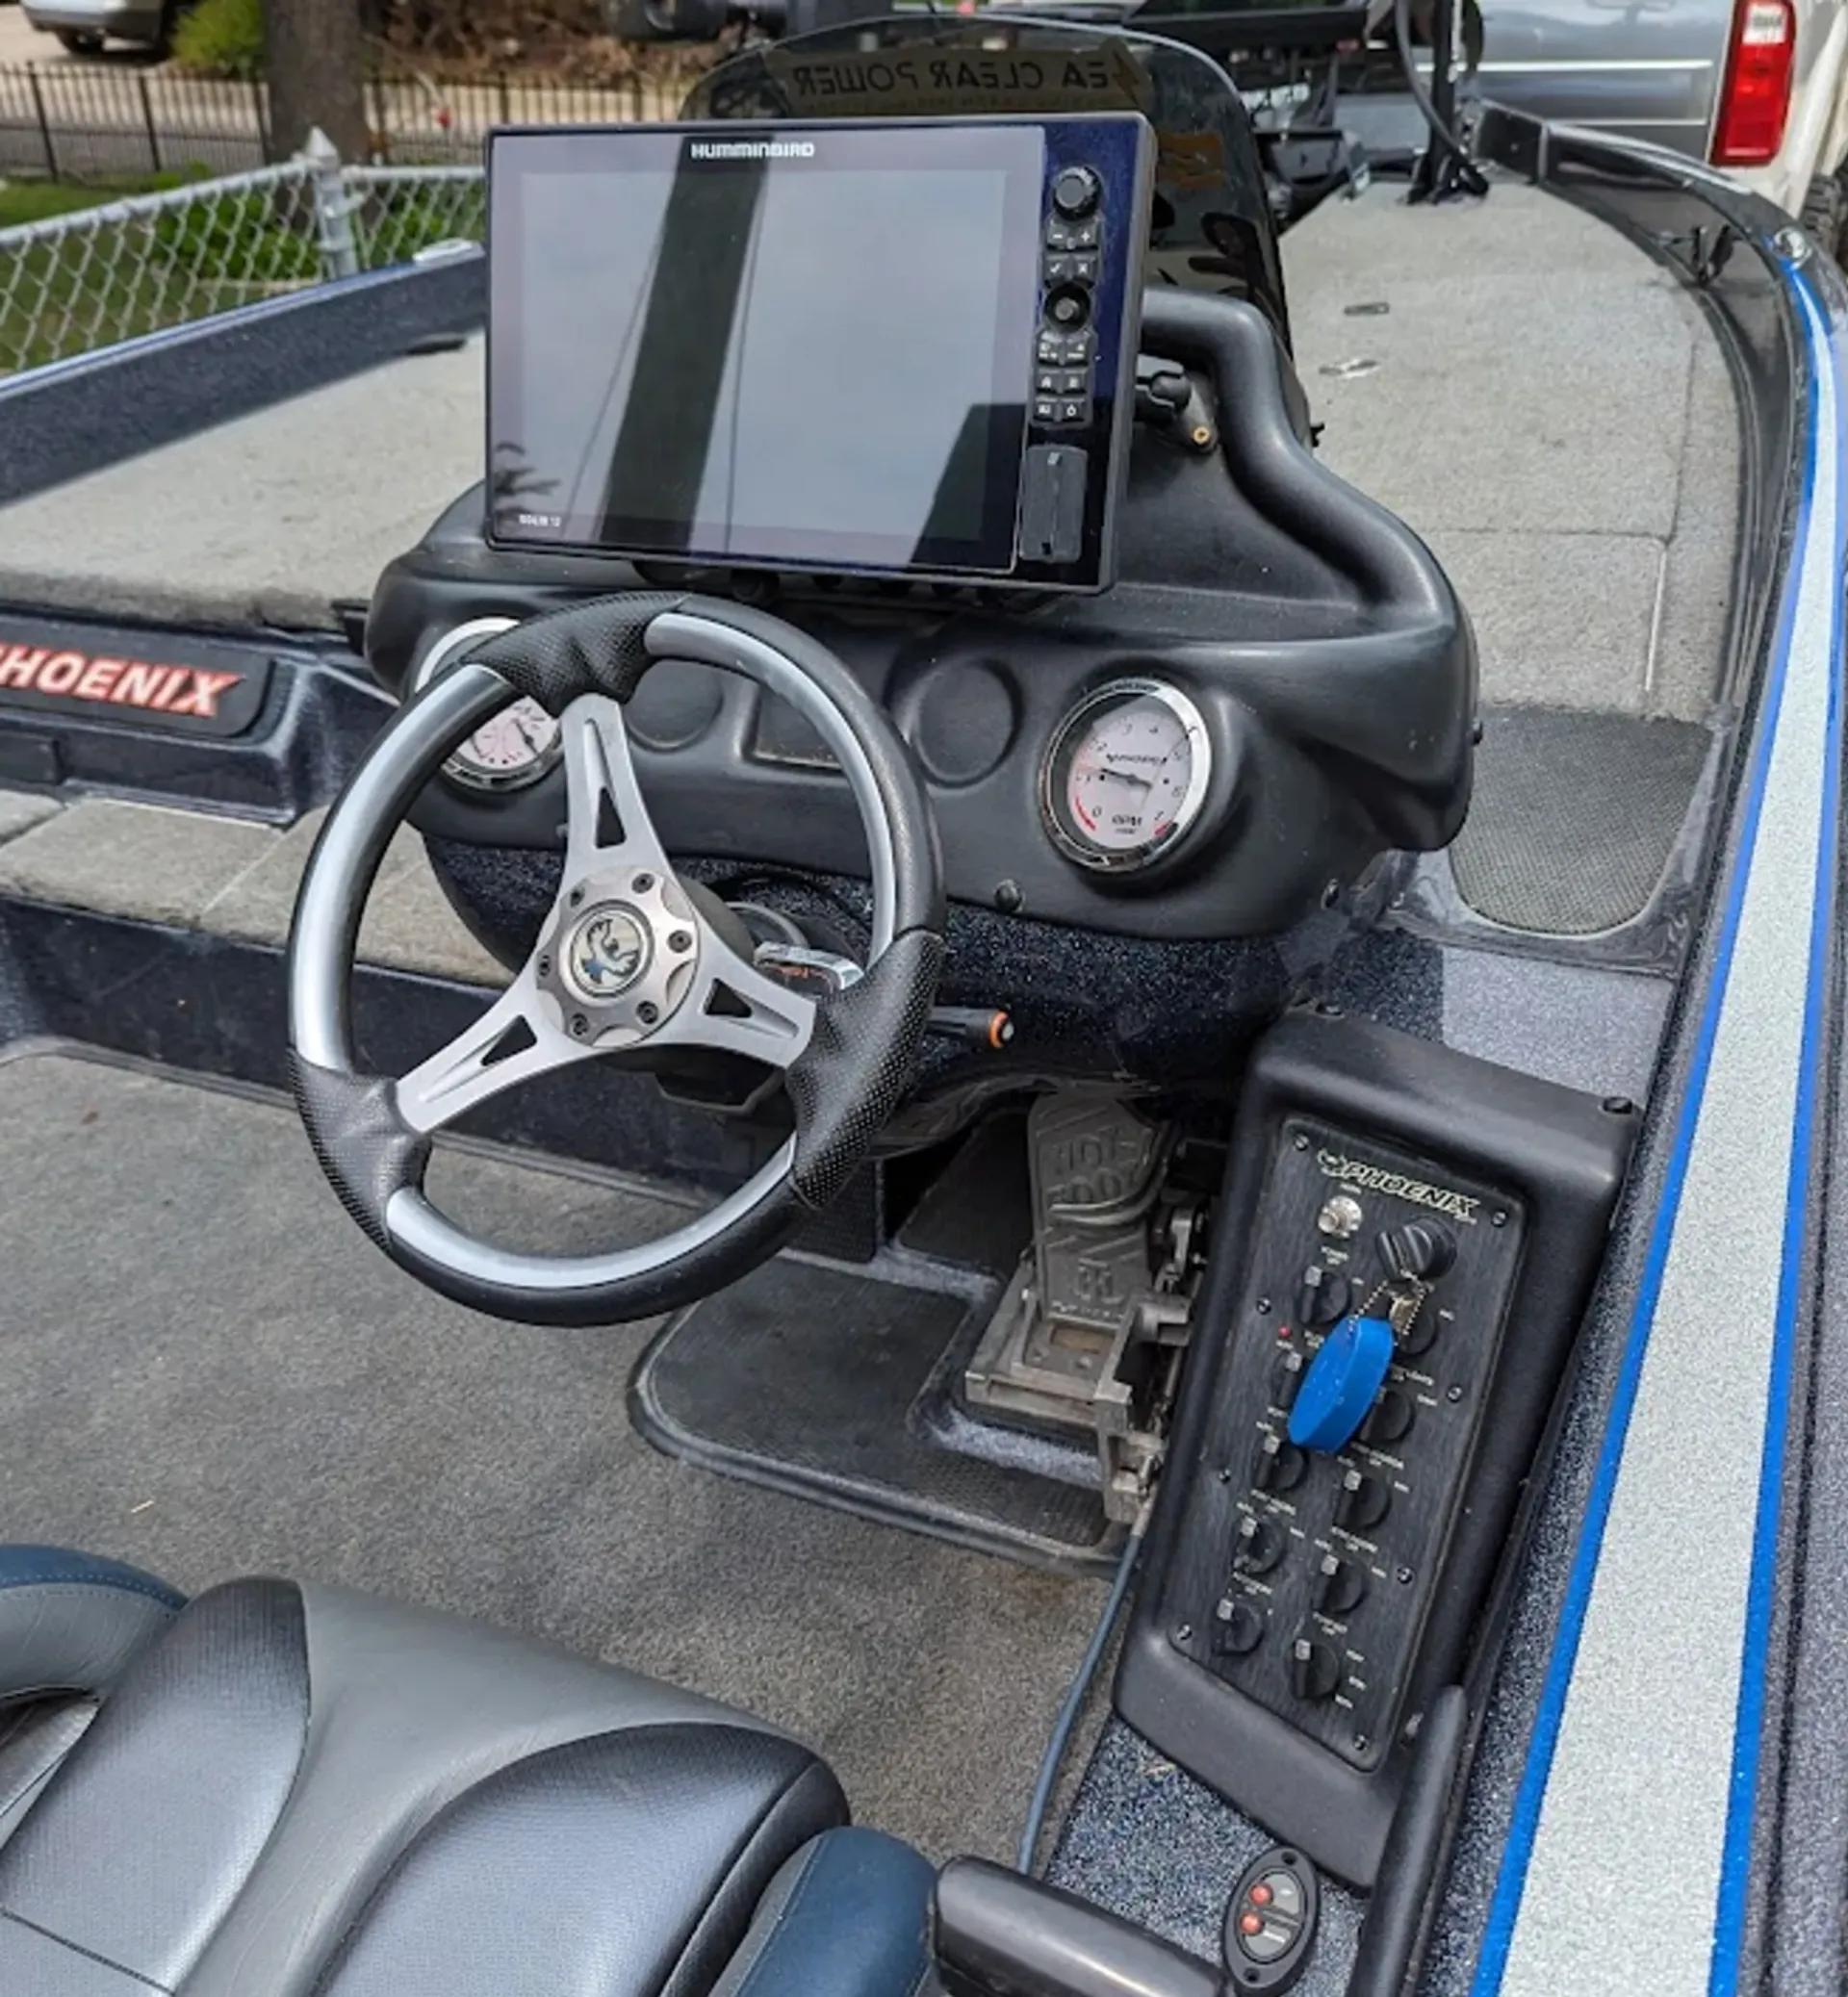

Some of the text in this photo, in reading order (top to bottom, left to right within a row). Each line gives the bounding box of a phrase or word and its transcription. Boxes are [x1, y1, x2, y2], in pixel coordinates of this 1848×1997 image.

[690, 142, 815, 159] HUMMINBIRD
[0, 642, 246, 718] HOENIX
[1343, 1160, 1481, 1225] PHOENIX
